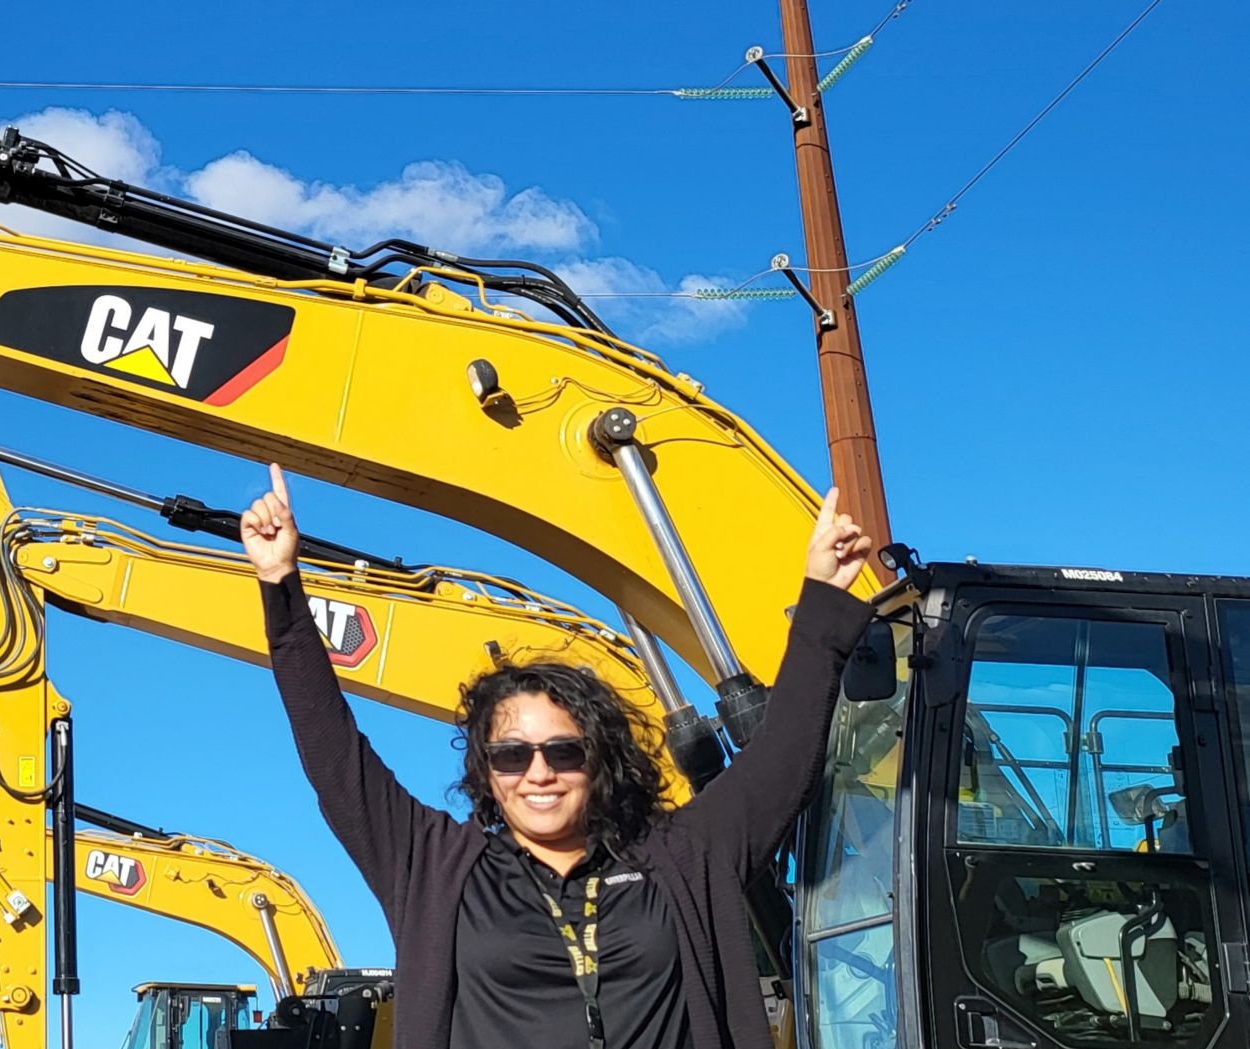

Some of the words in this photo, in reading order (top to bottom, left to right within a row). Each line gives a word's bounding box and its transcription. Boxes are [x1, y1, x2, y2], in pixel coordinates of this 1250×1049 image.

[81, 295, 215, 389] CAT
[307, 596, 356, 651] AT
[86, 850, 136, 887] CAT
